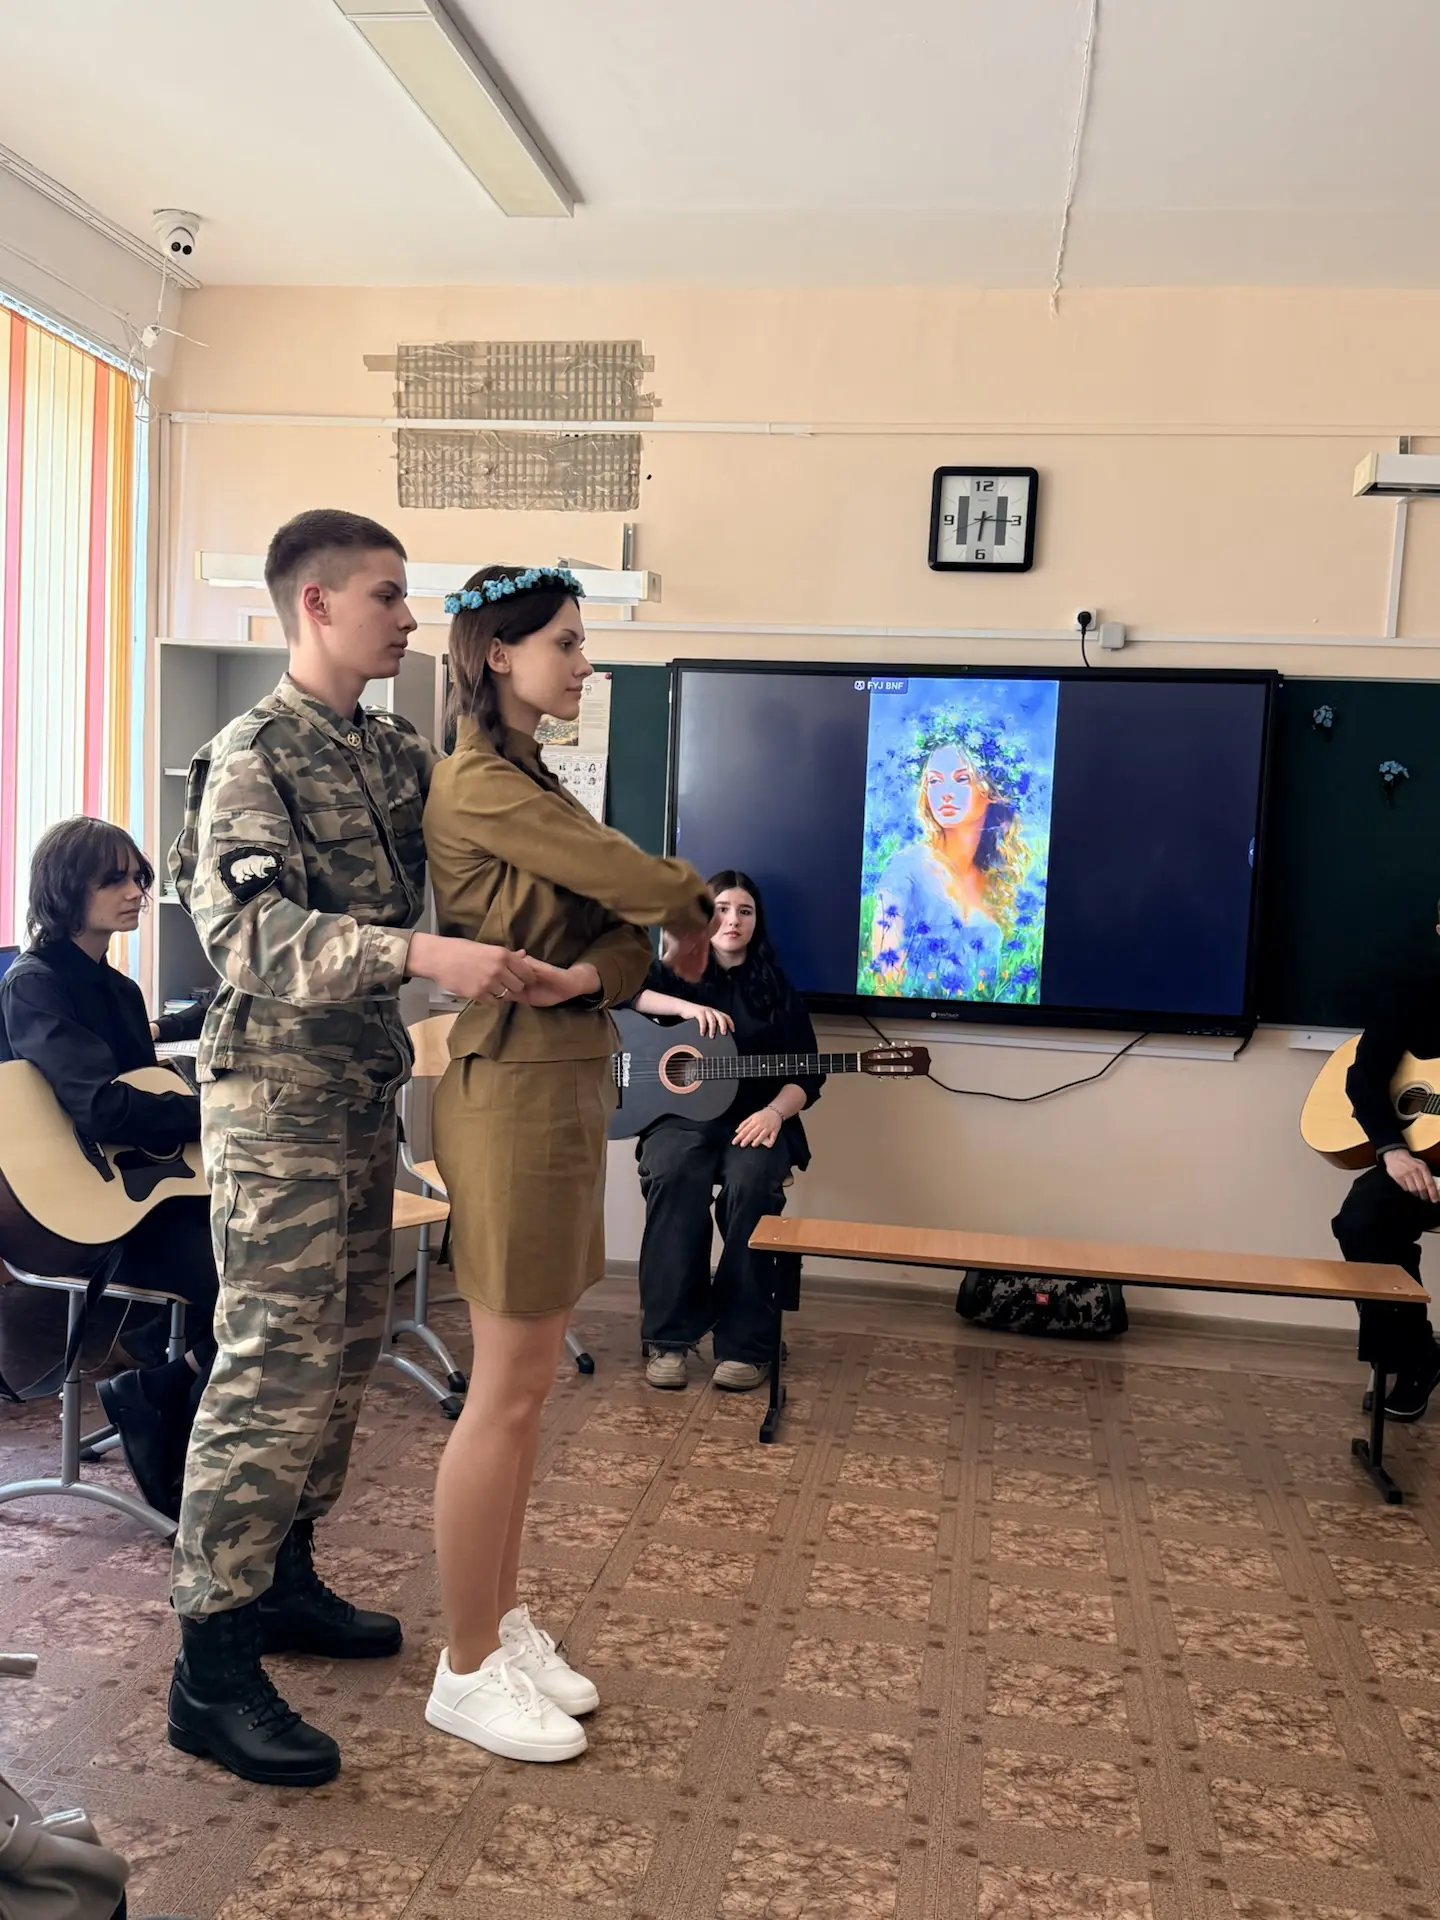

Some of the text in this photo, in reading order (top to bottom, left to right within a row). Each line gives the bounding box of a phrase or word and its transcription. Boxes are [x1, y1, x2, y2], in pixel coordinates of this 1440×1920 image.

[975, 480, 994, 492] 12
[943, 514, 954, 526] 9
[1010, 515, 1022, 526] 3
[975, 549, 986, 560] 6
[867, 681, 904, 690] FYJ BNF
